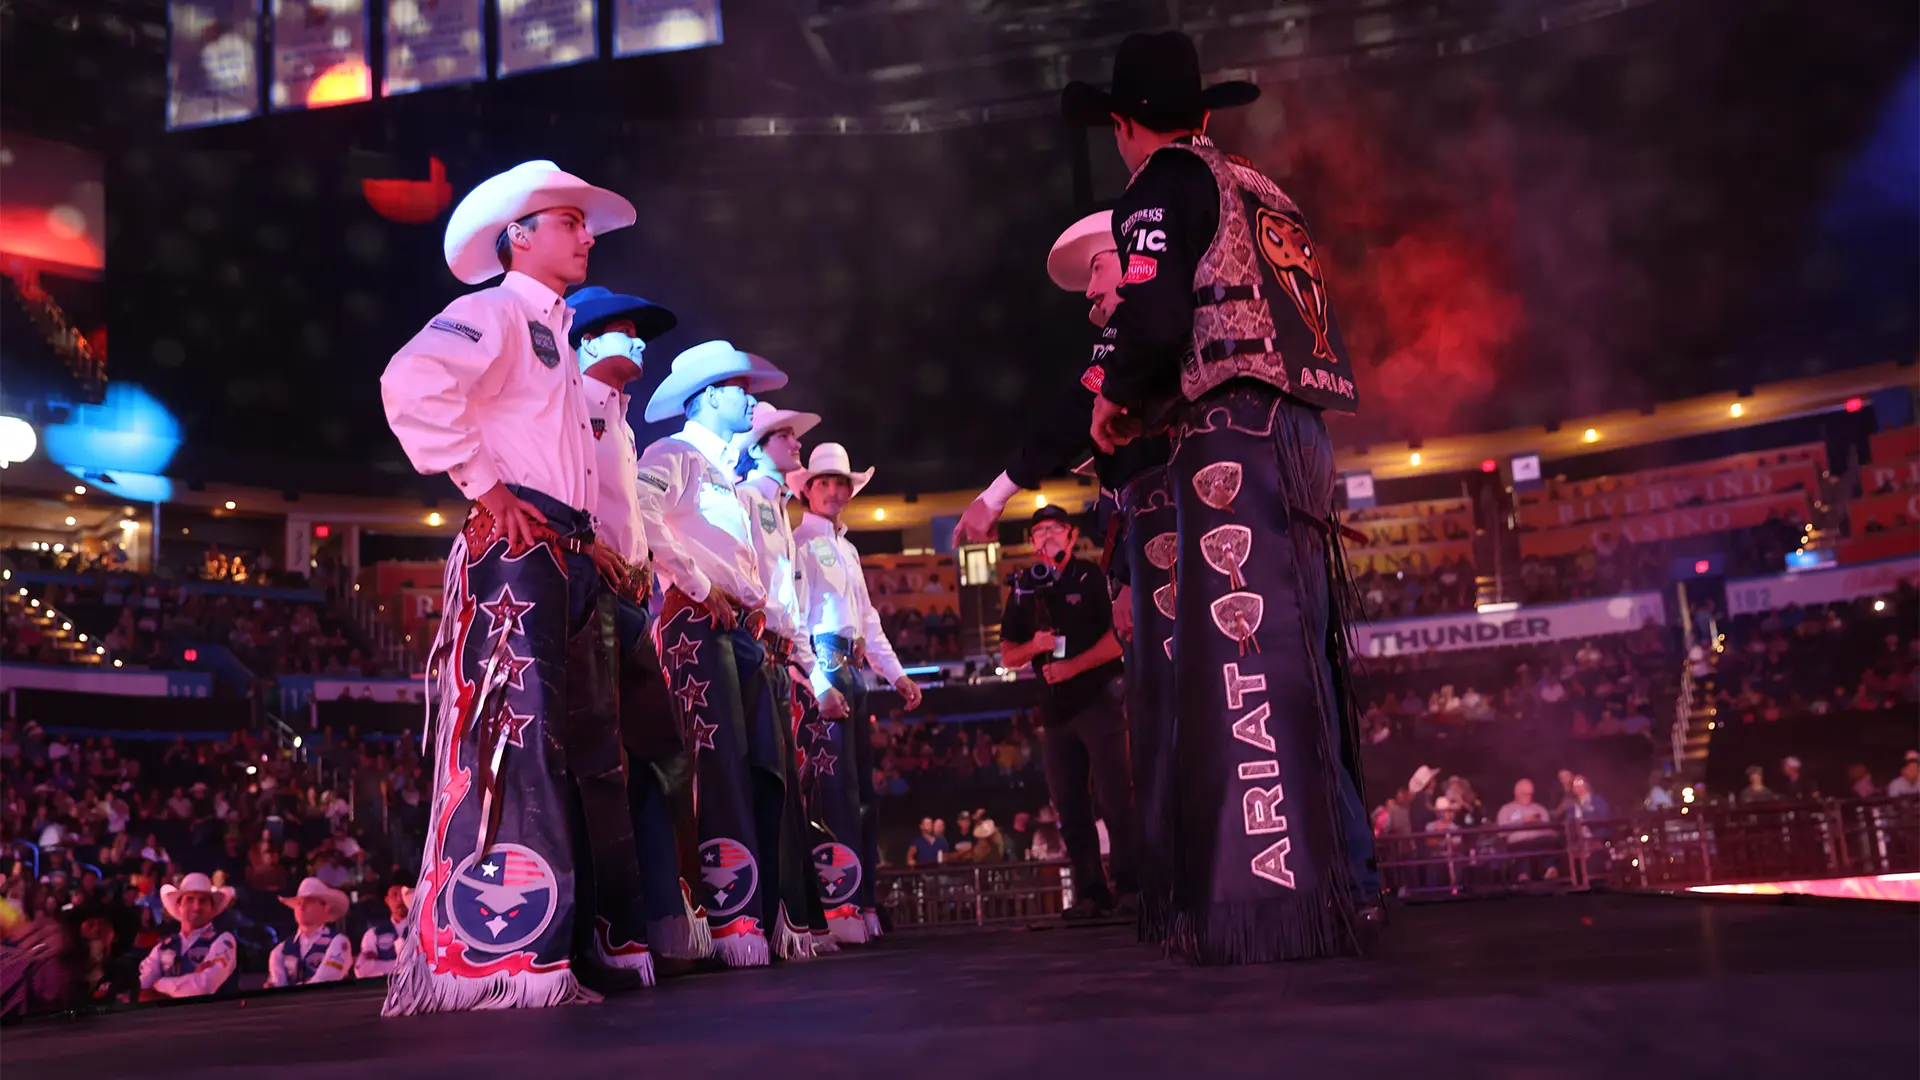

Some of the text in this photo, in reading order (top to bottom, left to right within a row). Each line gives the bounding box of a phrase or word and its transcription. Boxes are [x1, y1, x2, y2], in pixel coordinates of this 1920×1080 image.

[1300, 367, 1355, 400] ARIAT
[1369, 617, 1552, 652] THUNDER
[1223, 662, 1296, 890] ARIAT
